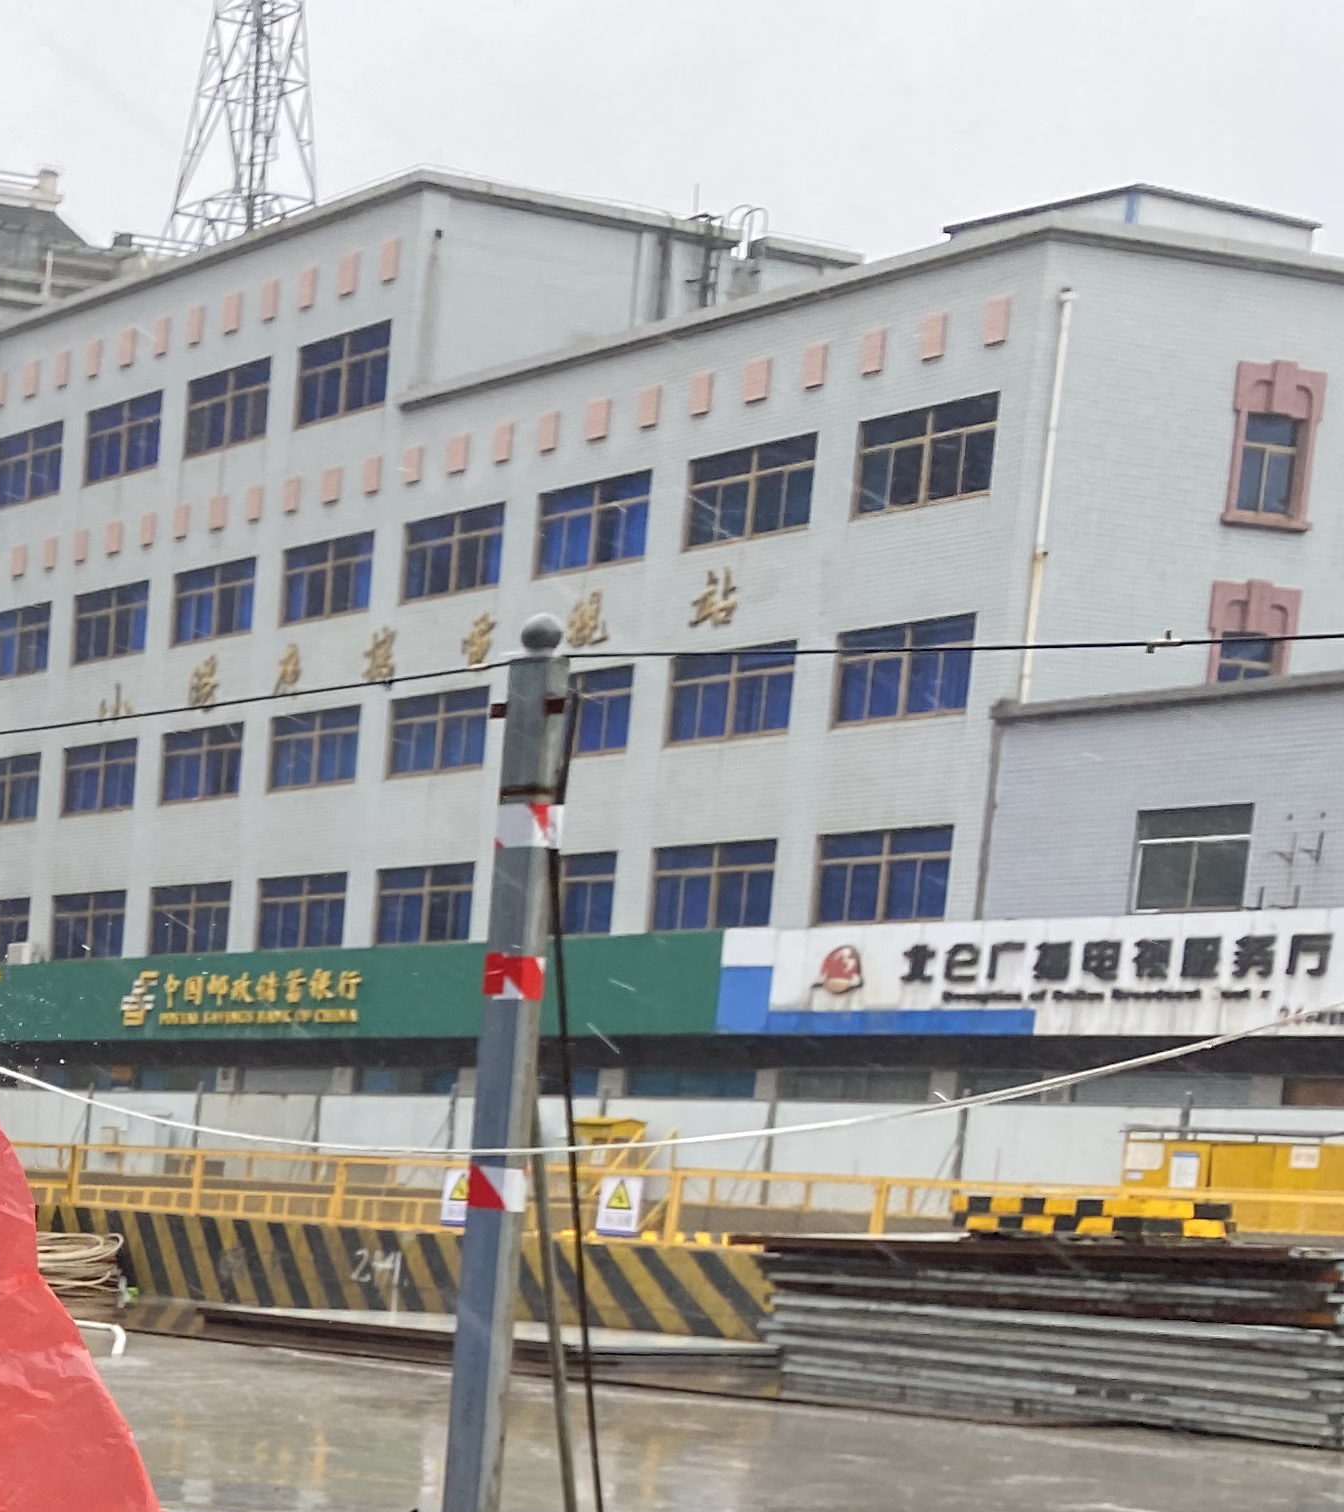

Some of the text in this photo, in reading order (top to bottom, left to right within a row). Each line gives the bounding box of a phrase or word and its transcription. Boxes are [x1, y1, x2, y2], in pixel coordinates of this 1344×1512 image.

[163, 968, 362, 1009] 中国邮政储蓄银行
